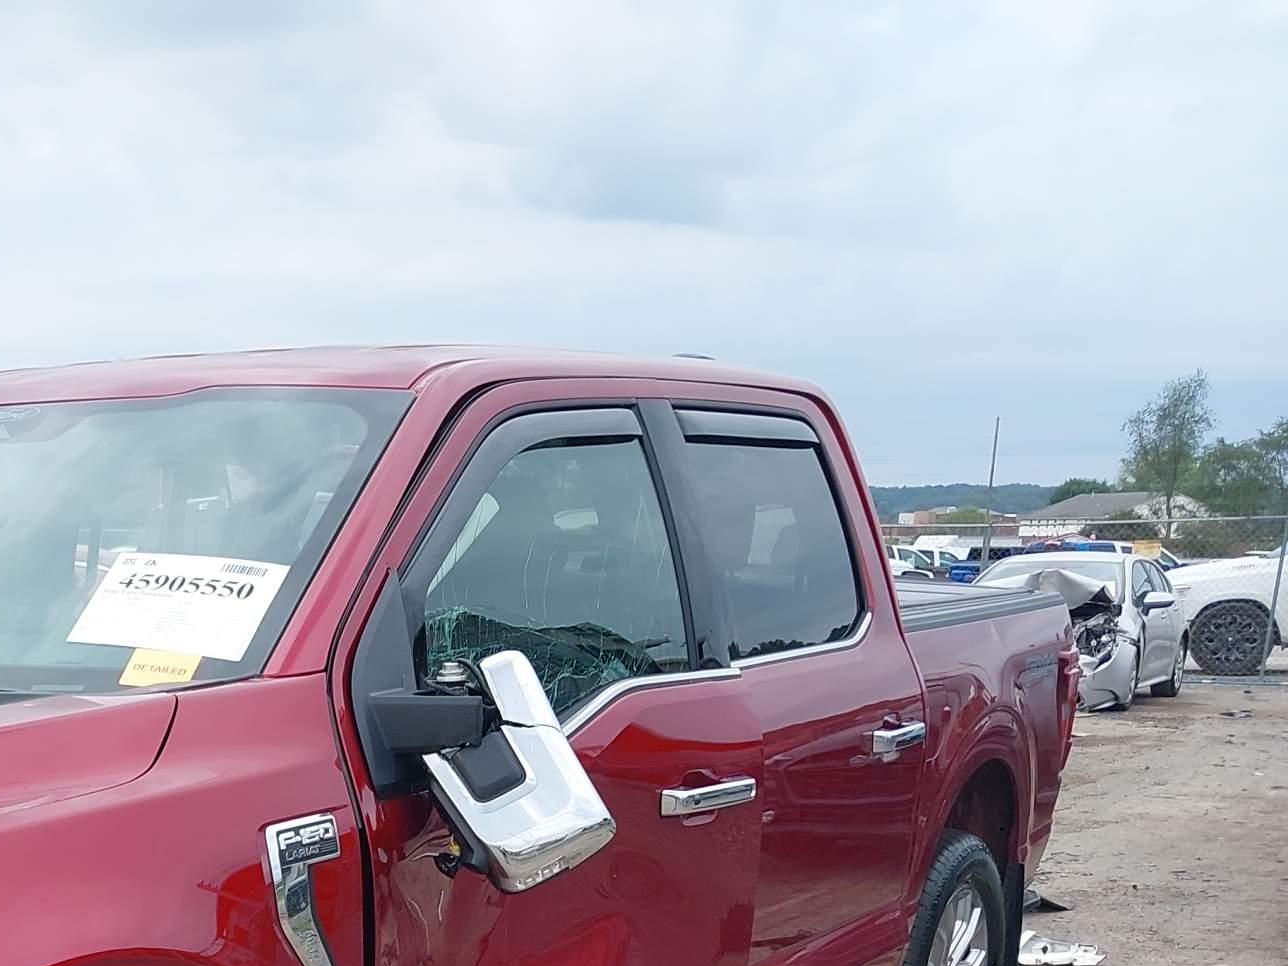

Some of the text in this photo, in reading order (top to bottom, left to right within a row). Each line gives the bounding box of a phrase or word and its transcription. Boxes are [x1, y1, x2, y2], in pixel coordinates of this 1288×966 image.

[118, 572, 255, 600] 45905550
[132, 663, 188, 676] DETAILED
[285, 844, 321, 862] LARIAT
